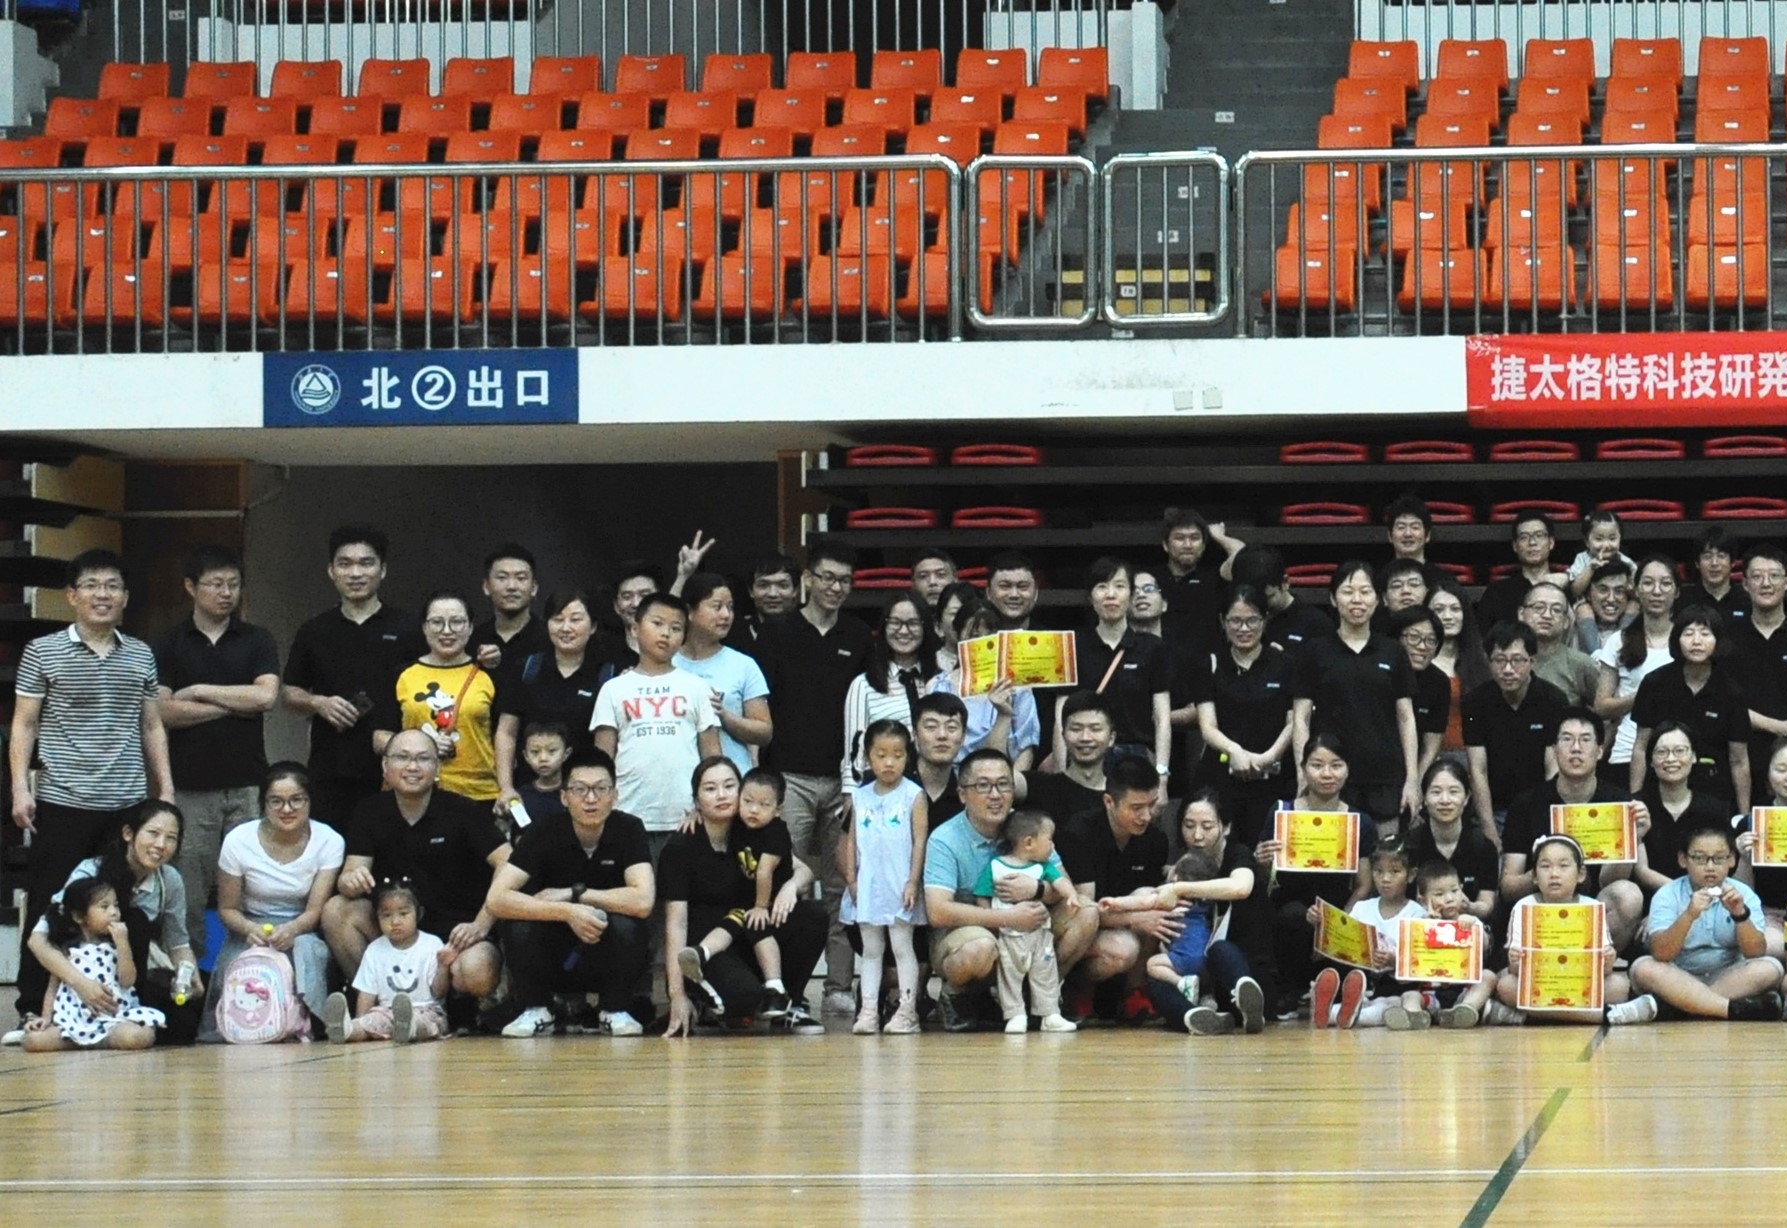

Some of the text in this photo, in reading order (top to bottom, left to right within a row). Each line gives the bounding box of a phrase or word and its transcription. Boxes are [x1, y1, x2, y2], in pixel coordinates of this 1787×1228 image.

[637, 686, 670, 695] TEAM
[623, 695, 687, 722] NYC
[636, 726, 653, 738] EST
